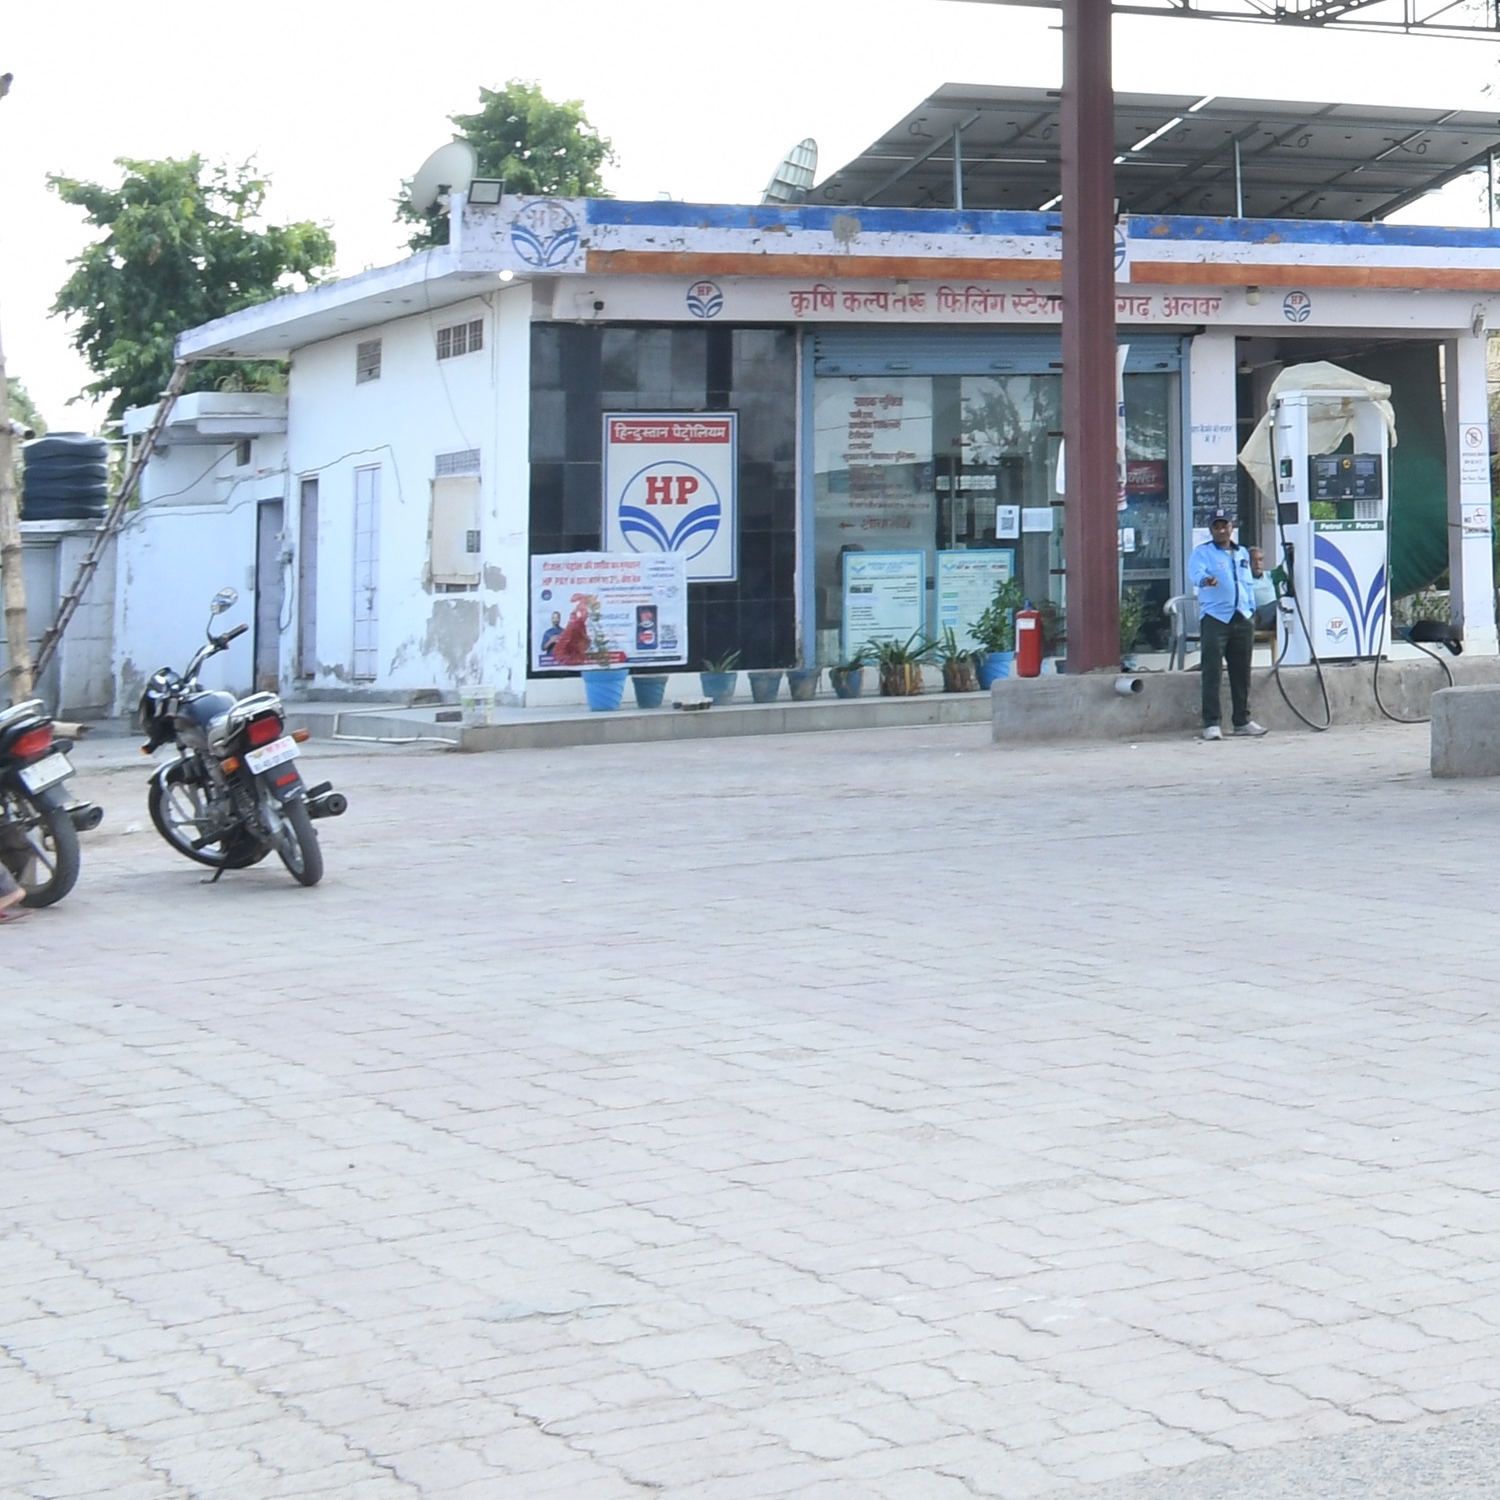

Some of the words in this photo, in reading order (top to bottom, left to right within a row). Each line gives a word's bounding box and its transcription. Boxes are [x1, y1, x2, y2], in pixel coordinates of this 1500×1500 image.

[697, 286, 713, 296] HP
[936, 284, 1006, 315] फिलिंग
[1161, 293, 1222, 317] अलवर
[1291, 295, 1304, 305] HP
[645, 475, 699, 505] HP
[1320, 522, 1342, 530] Petrol
[1355, 522, 1378, 530] Petrol
